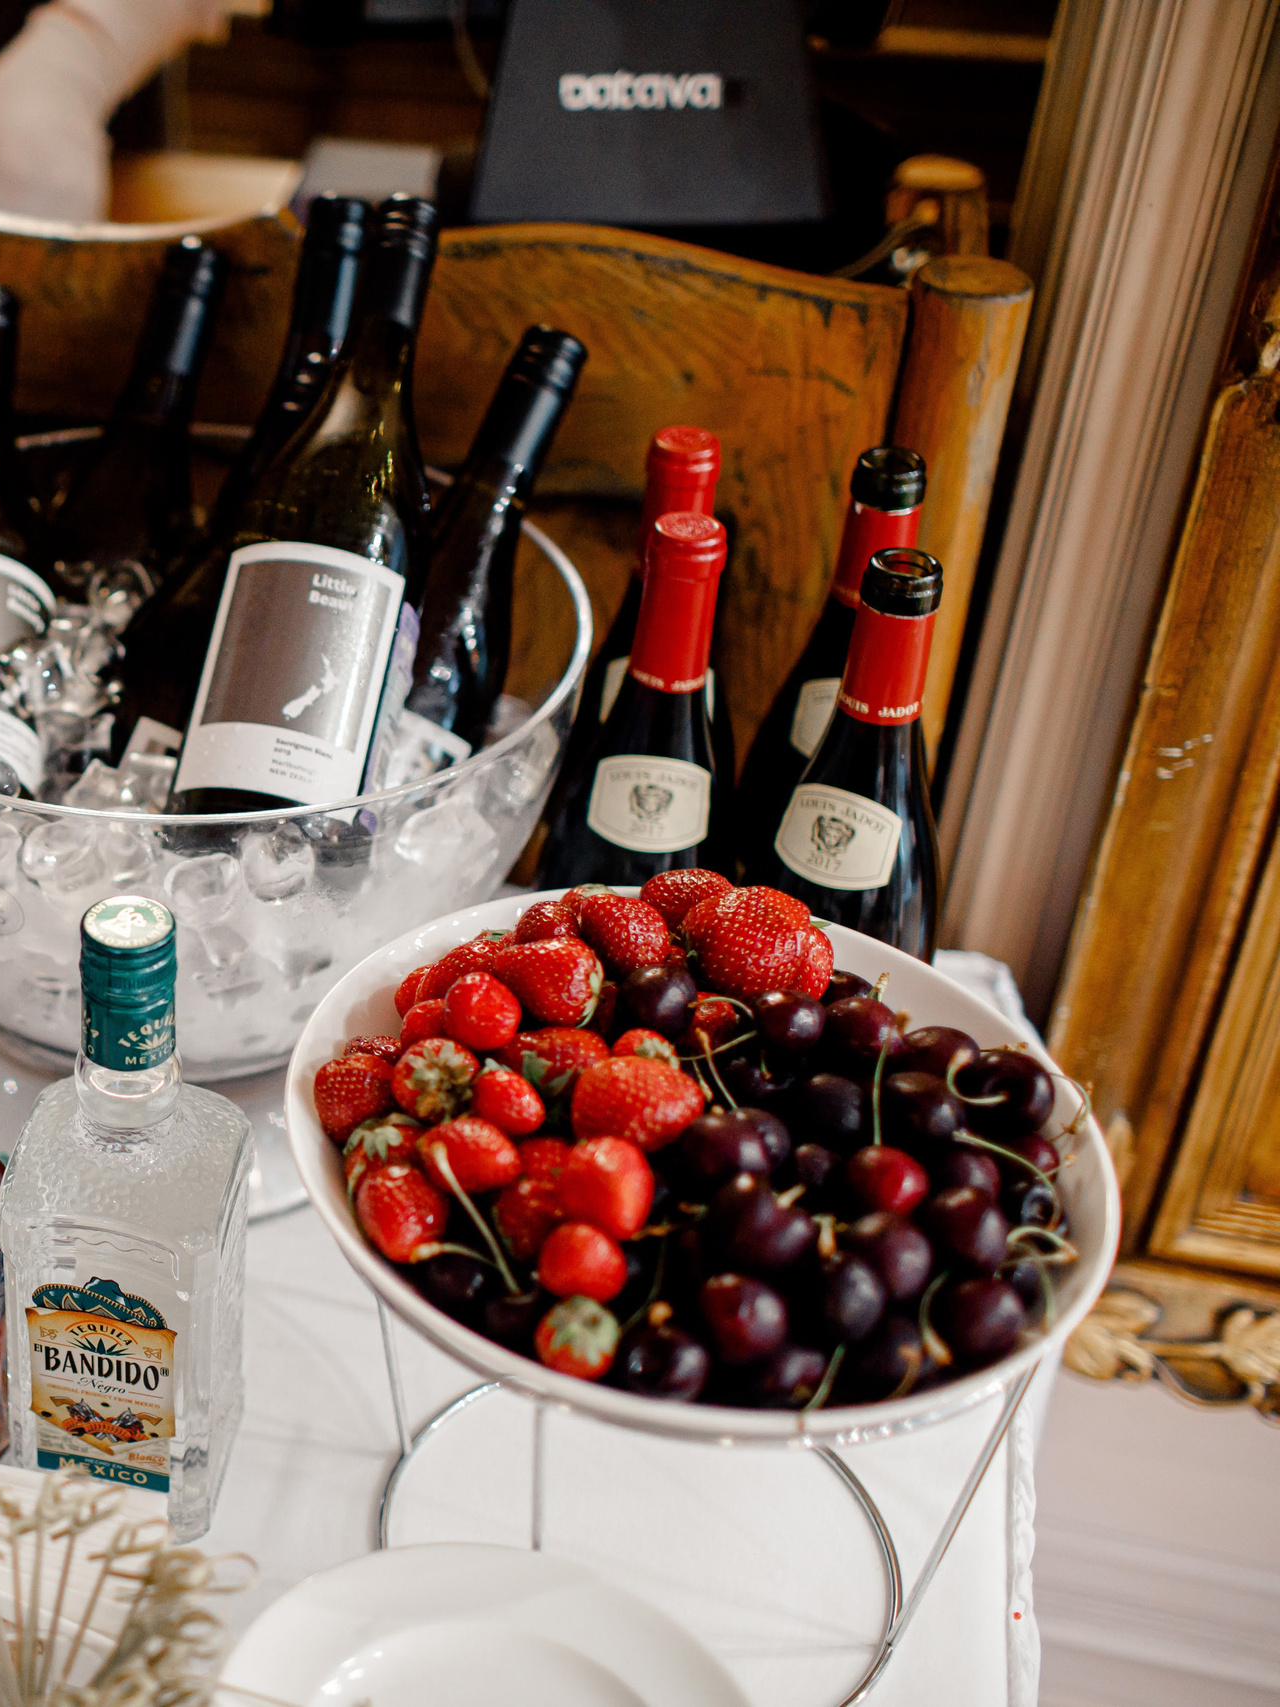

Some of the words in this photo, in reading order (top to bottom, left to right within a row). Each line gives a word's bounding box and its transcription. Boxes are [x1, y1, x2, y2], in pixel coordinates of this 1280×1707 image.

[308, 589, 354, 614] Beaut
[877, 700, 921, 719] JADOT
[68, 1322, 133, 1346] TEQUILA
[44, 1345, 160, 1392] BANDIDO
[46, 1383, 79, 1394] ORIGINAL
[80, 1389, 113, 1400] PRODUCT
[113, 1395, 133, 1404] FROM
[134, 1400, 161, 1410] MEXICO
[76, 1376, 127, 1395] Negro
[128, 1452, 166, 1464] Blanco
